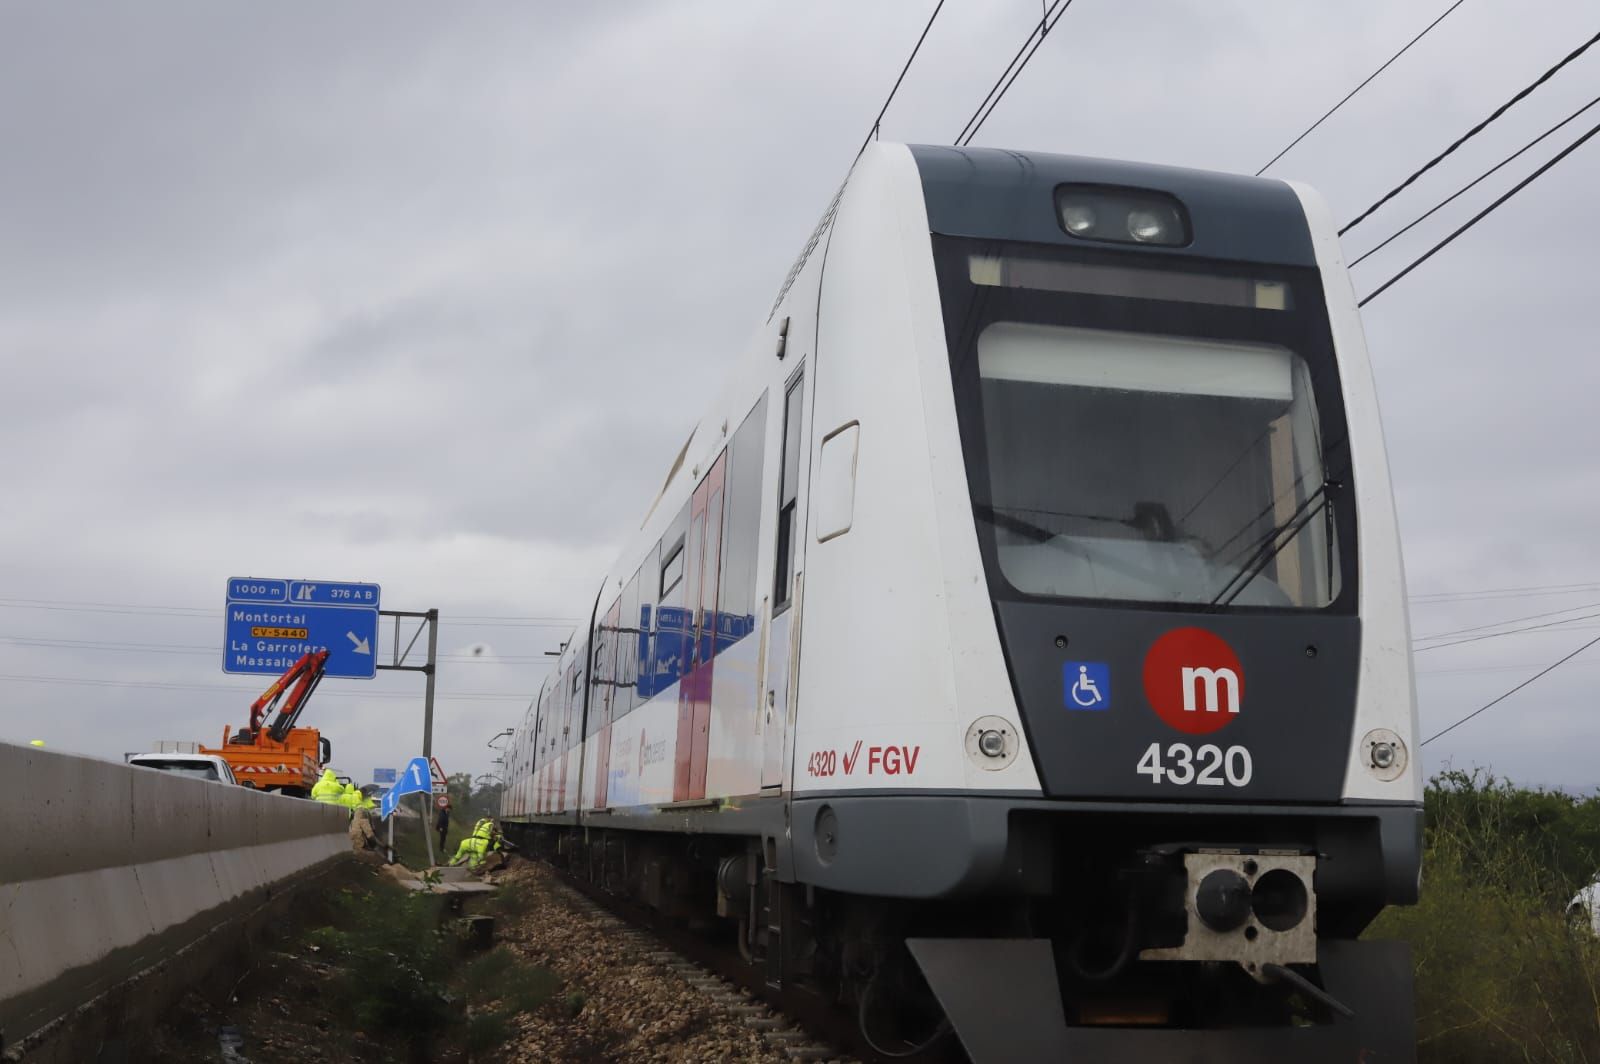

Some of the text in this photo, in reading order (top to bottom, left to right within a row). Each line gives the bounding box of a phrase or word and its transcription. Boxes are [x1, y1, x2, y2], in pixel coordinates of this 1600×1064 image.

[235, 585, 280, 595] 1000 m
[331, 589, 372, 600] 376 A B
[233, 611, 306, 624] Montortal
[252, 628, 306, 638] CV-5440
[232, 640, 327, 653] La Garrofera
[236, 655, 321, 669] Massala
[1182, 667, 1240, 713] m
[808, 746, 920, 776] 4320 FGV
[1136, 742, 1252, 787] 4320
